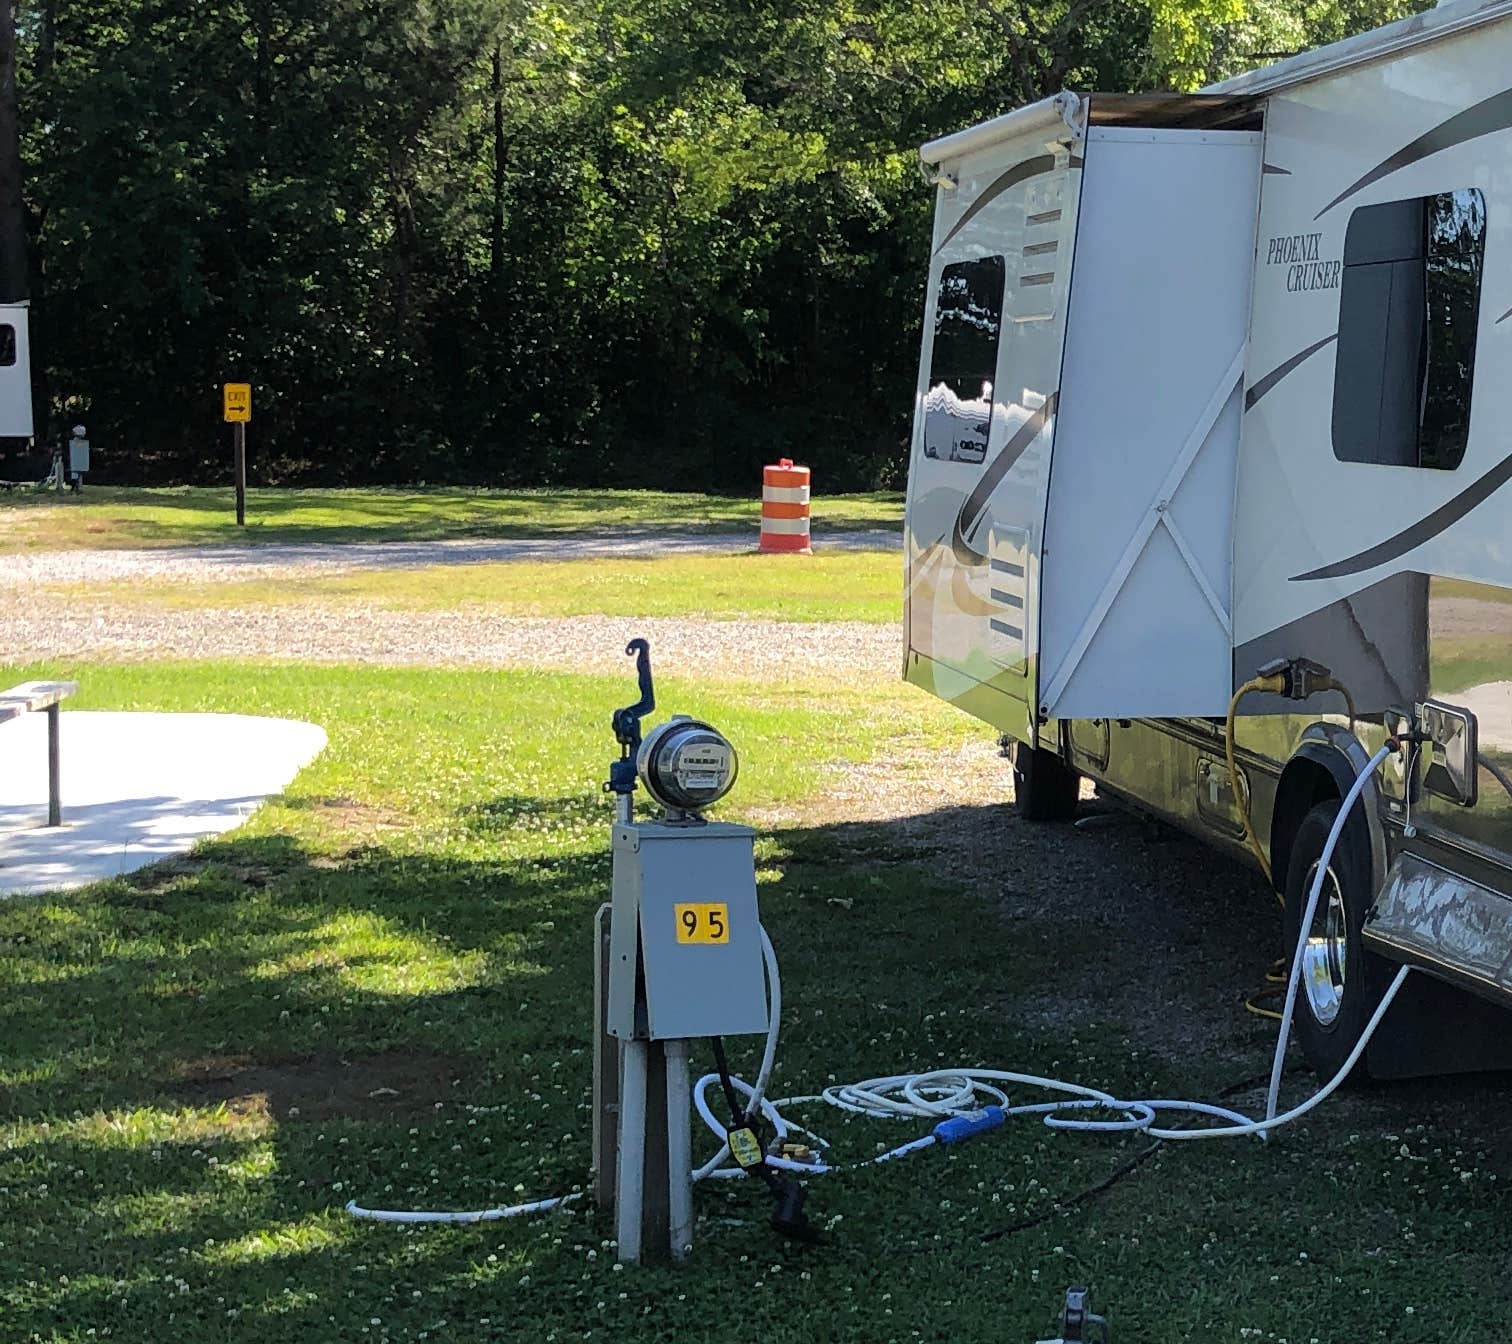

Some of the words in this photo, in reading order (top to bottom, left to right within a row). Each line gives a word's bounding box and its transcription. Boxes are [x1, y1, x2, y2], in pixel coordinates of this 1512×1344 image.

[1266, 233, 1322, 265] PHOENIX
[1287, 260, 1341, 292] CRUISER
[682, 910, 724, 939] 95
